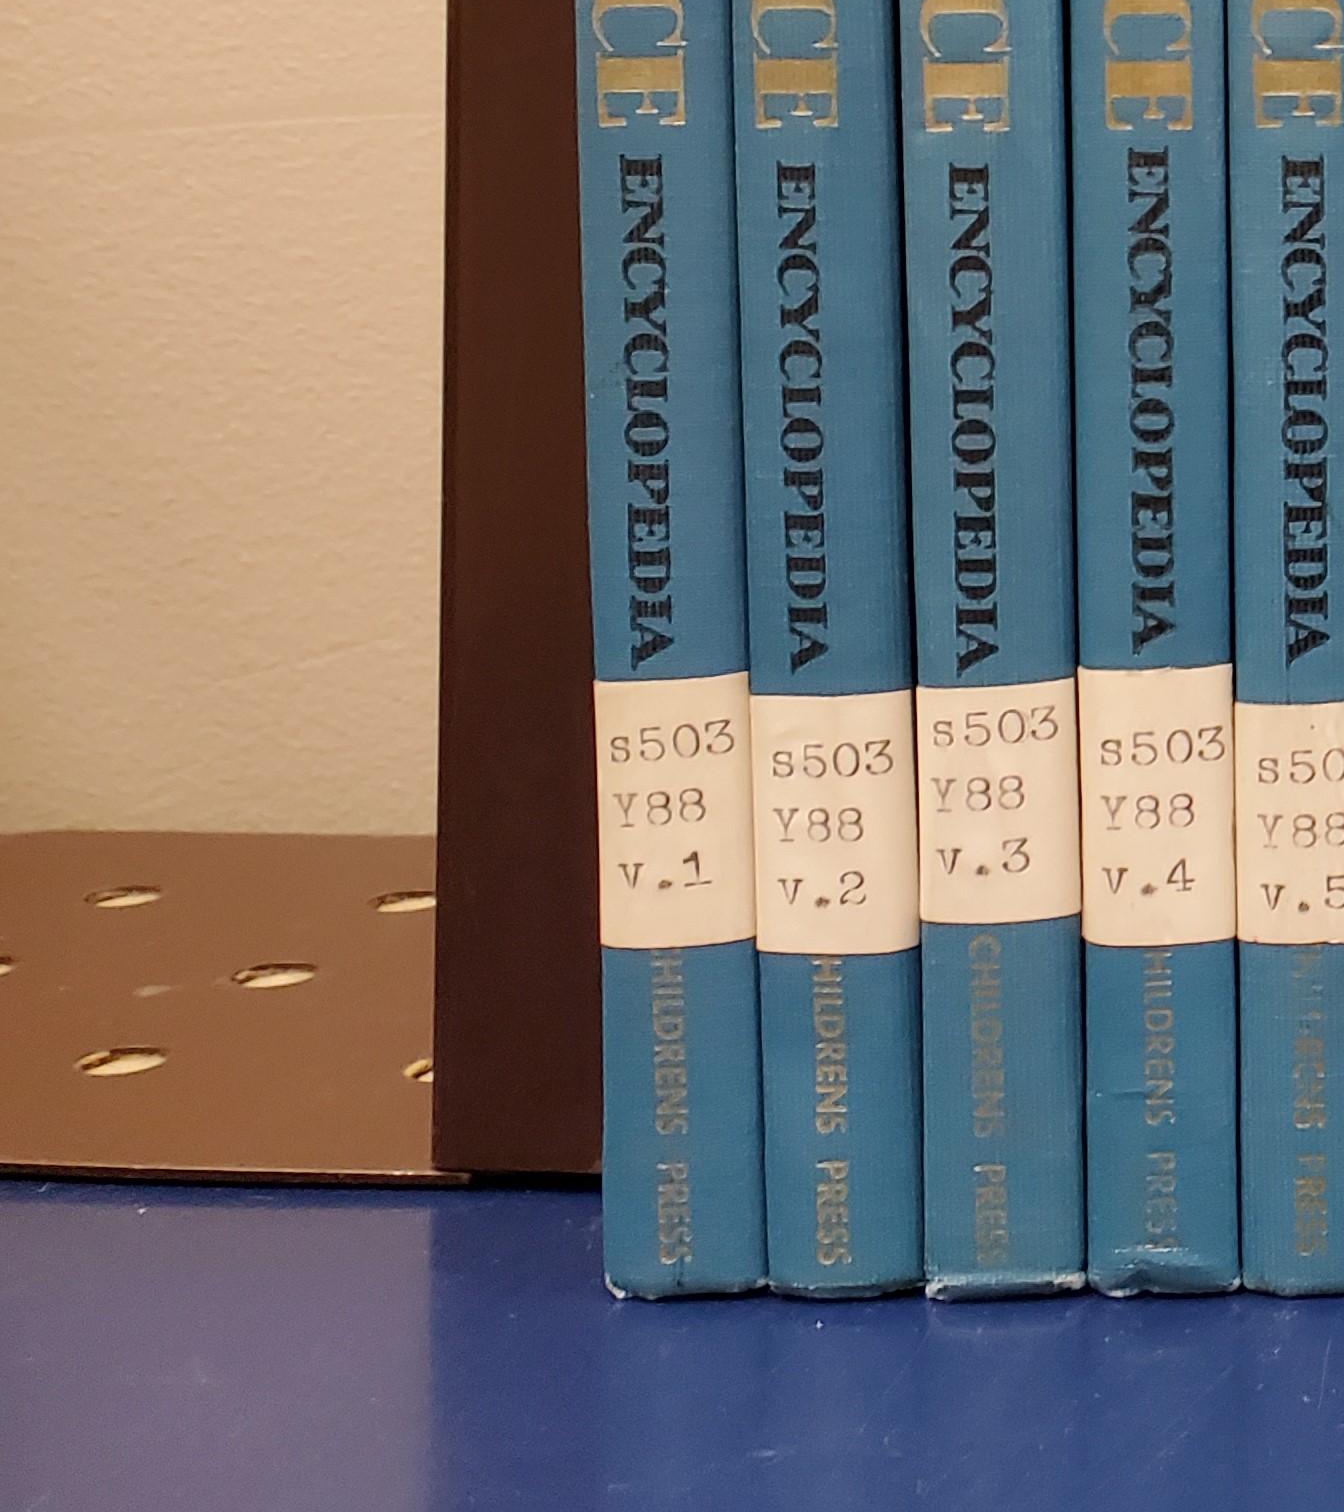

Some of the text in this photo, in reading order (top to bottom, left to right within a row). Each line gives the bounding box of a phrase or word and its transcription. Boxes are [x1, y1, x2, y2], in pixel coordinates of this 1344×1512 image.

[619, 153, 675, 671] ENCYCLOPEDIA
[948, 162, 1000, 678] ENCYCLOPEDIA
[1281, 155, 1331, 669] ENCYCLOPEDIA
[612, 787, 707, 828] Y88
[931, 775, 1026, 813] Y88
[1100, 792, 1195, 831] Y88
[772, 807, 864, 843] Y88
